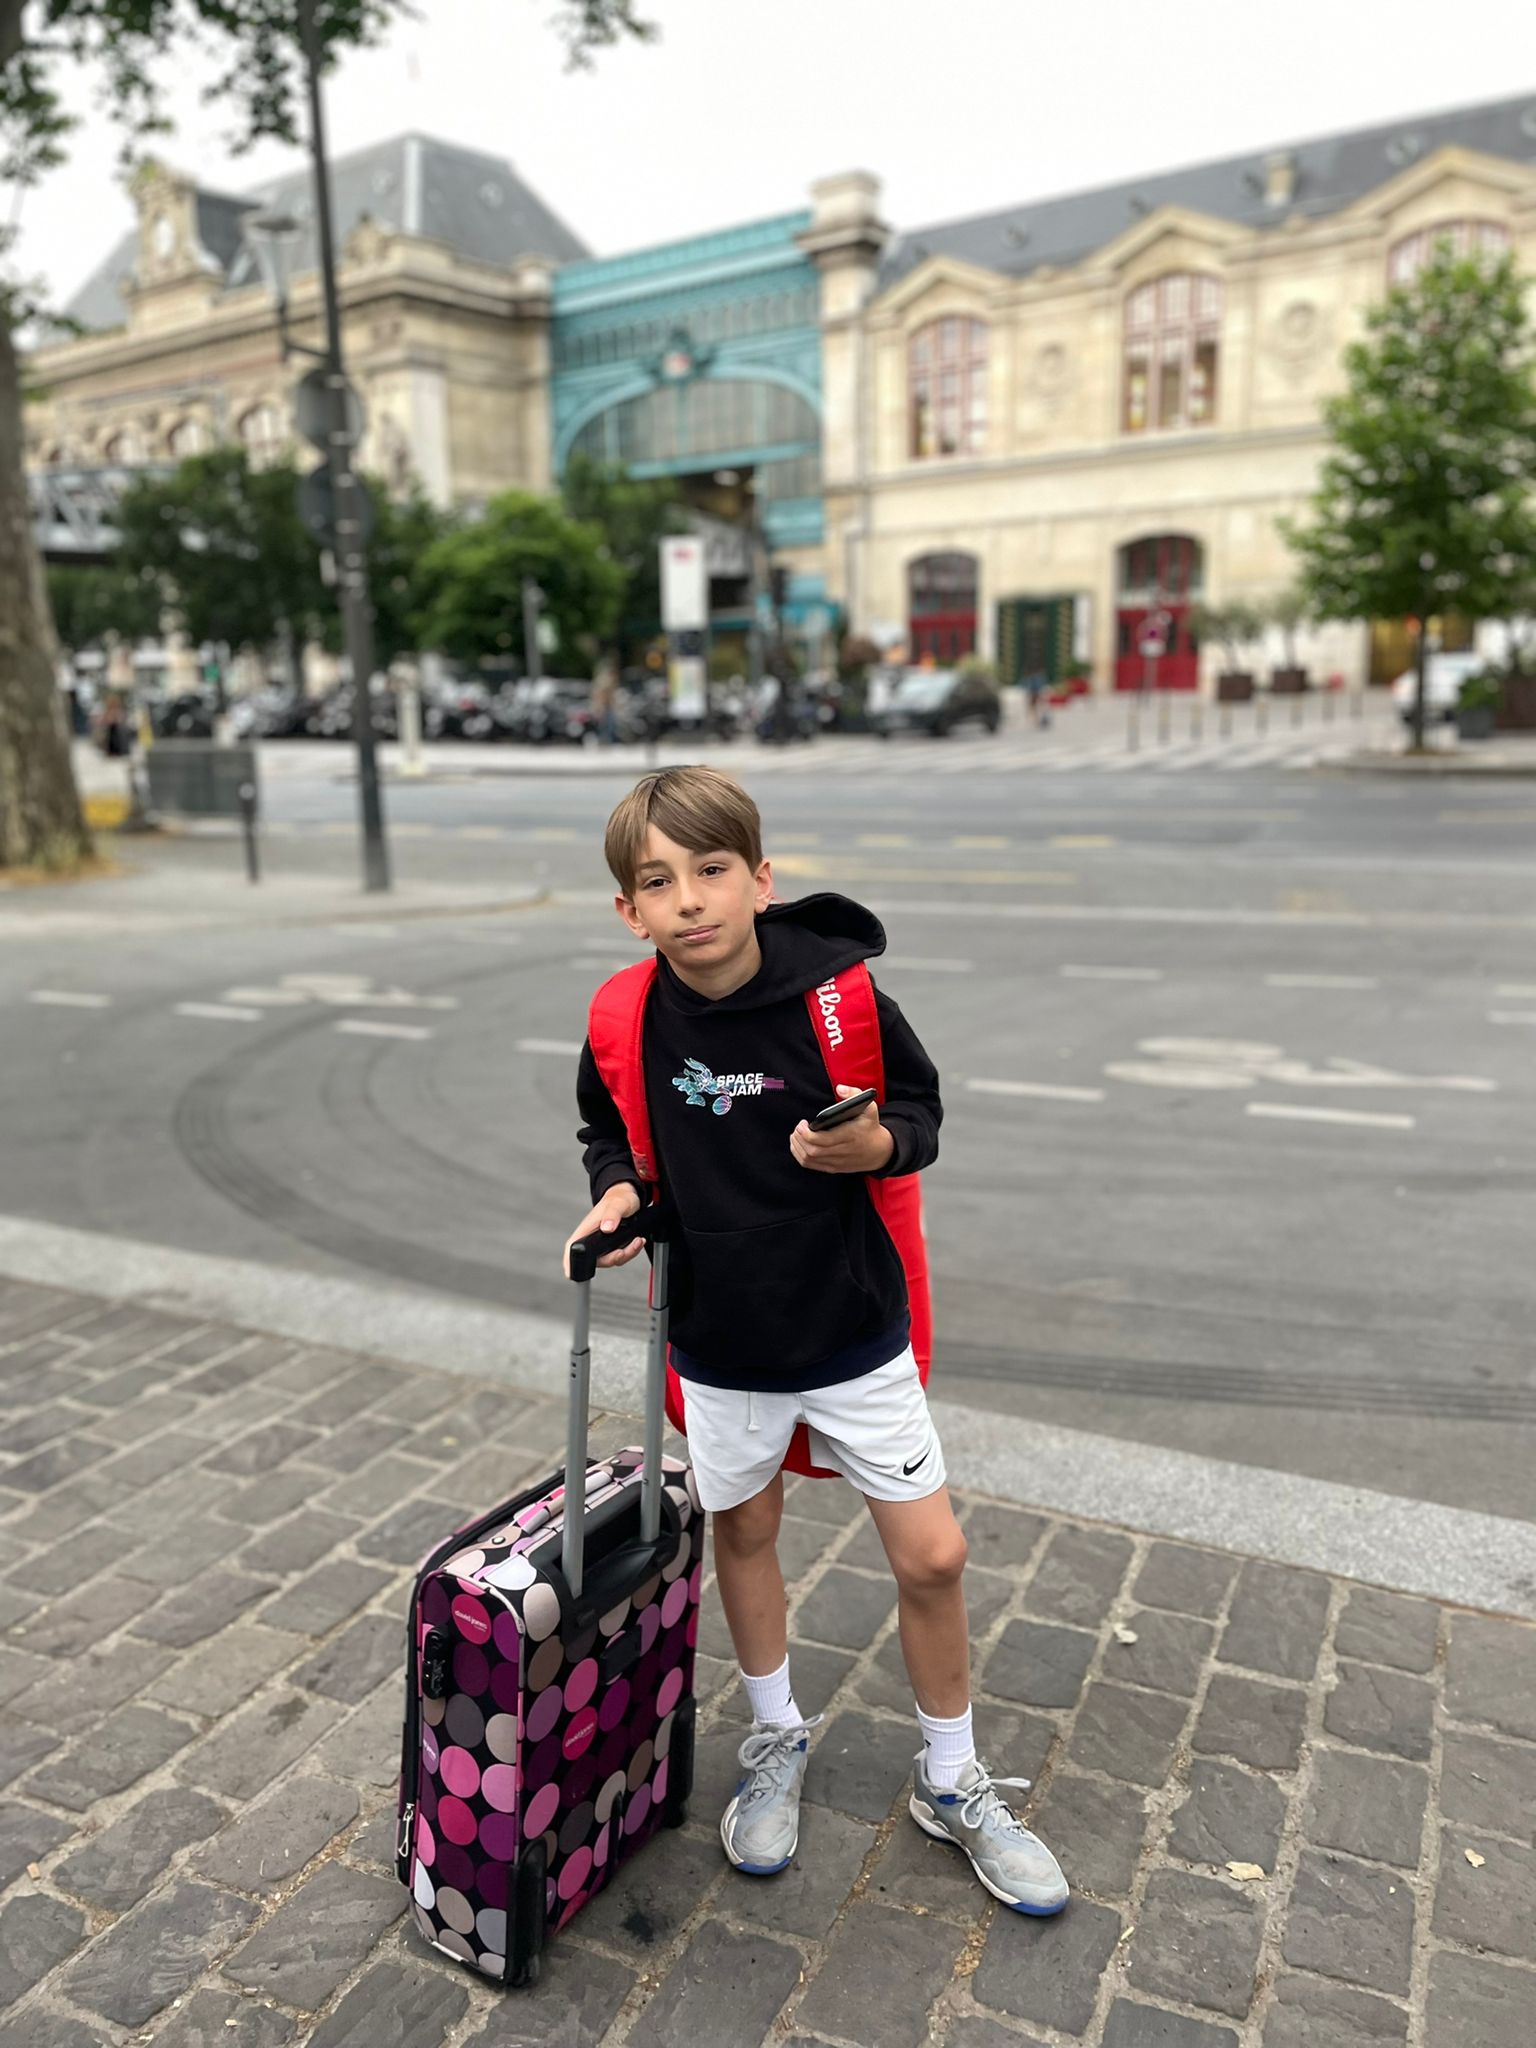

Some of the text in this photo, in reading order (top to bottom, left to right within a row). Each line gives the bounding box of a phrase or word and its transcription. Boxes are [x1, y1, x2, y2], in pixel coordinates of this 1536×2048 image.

[816, 977, 844, 1051] ilson
[717, 1073, 764, 1087] SPACE
[729, 1084, 763, 1097] JAM
